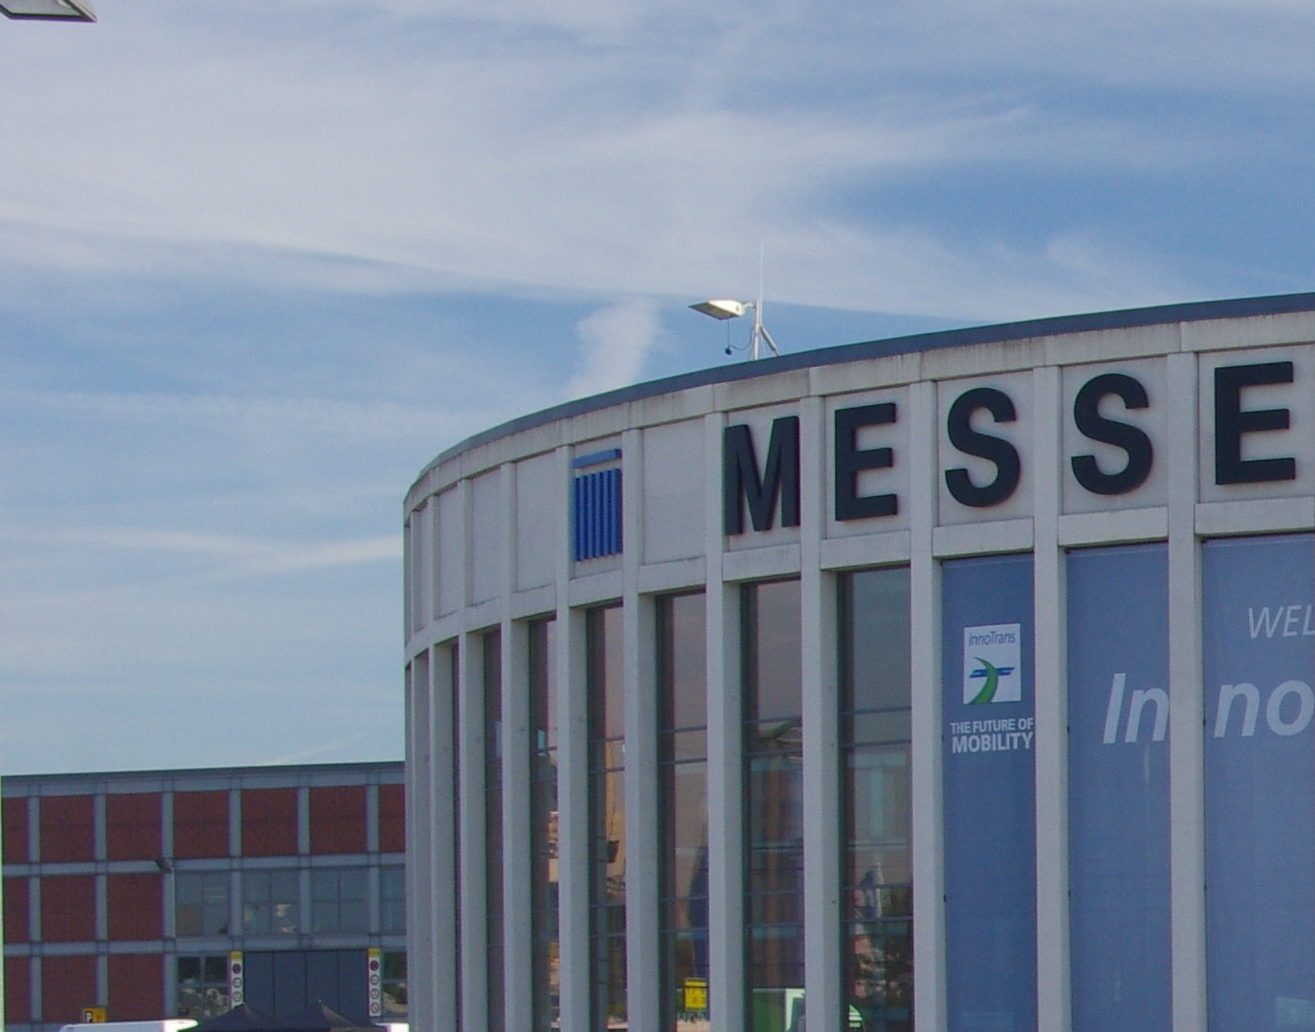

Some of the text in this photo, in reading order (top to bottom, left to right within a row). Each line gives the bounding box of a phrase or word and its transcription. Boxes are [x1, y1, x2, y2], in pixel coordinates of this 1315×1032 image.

[724, 361, 1296, 536] MESSE
[968, 631, 1016, 646] InnoTrans
[951, 717, 1034, 734] THE FUTURE OF
[952, 732, 1034, 753] MOBILITY
